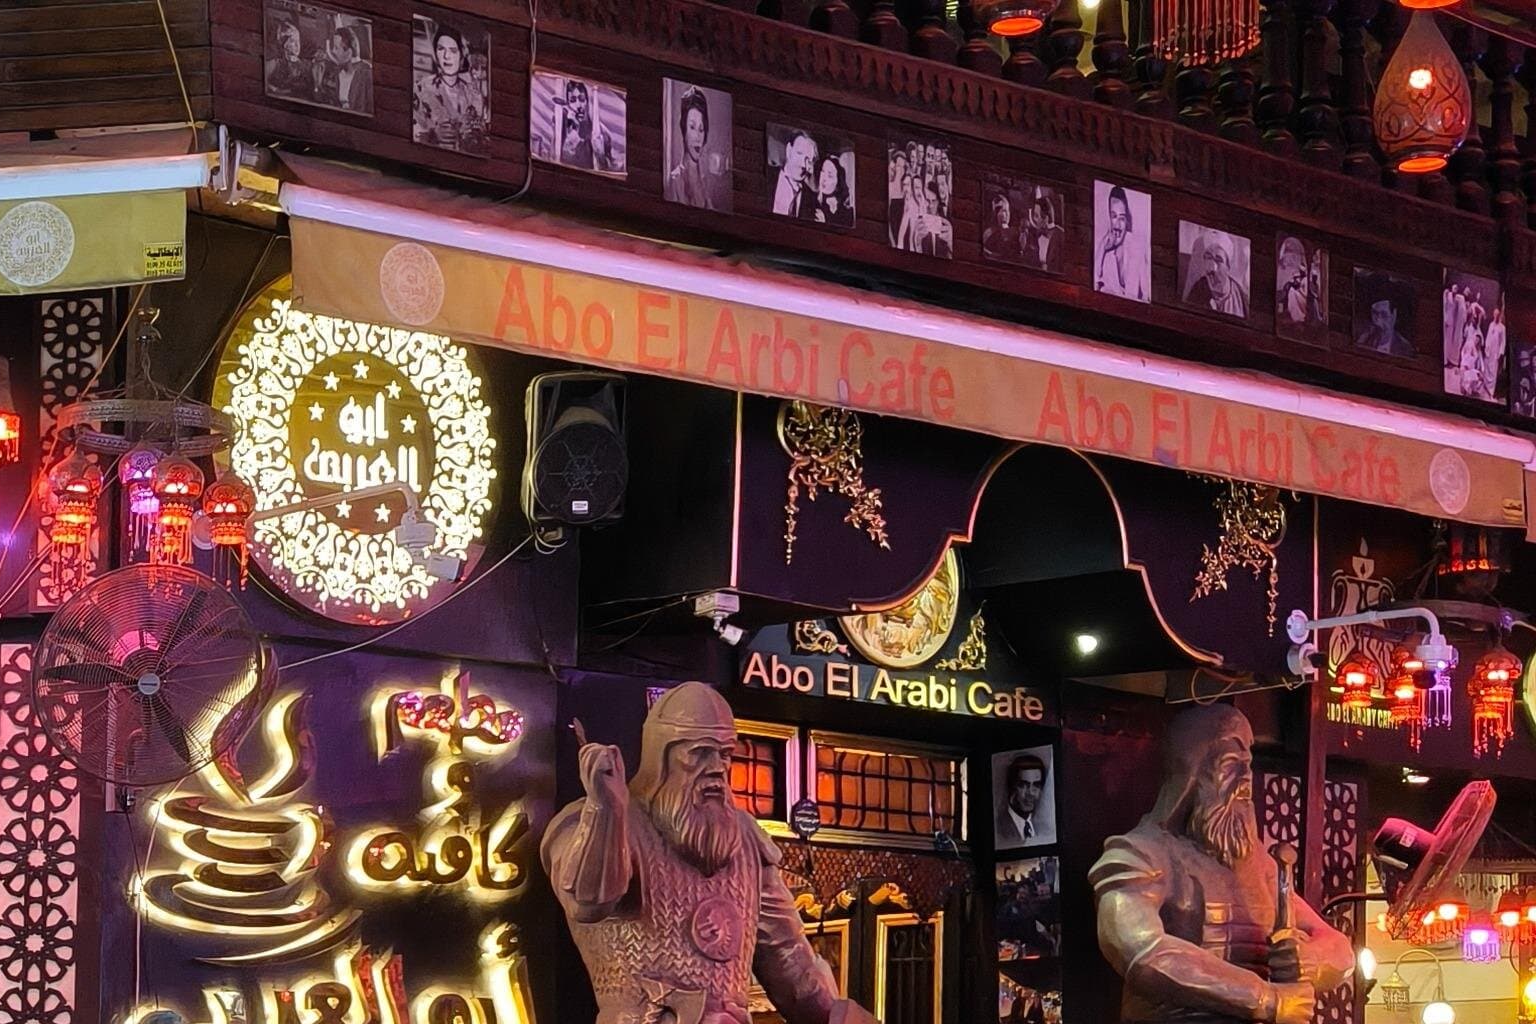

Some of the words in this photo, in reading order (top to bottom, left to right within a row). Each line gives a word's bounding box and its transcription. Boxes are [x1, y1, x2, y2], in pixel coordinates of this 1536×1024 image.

[493, 265, 615, 359] Abo
[636, 292, 688, 371] El
[706, 307, 819, 394] Arbi
[840, 331, 955, 419] Cafe
[1036, 373, 1134, 455] Abo
[1151, 392, 1192, 468] El
[1208, 406, 1294, 487] Arbi
[1311, 424, 1403, 505] Cafe
[743, 652, 814, 693] Abo
[826, 662, 859, 698] El
[870, 668, 957, 711] Arabi
[968, 682, 1044, 722] Cafe
